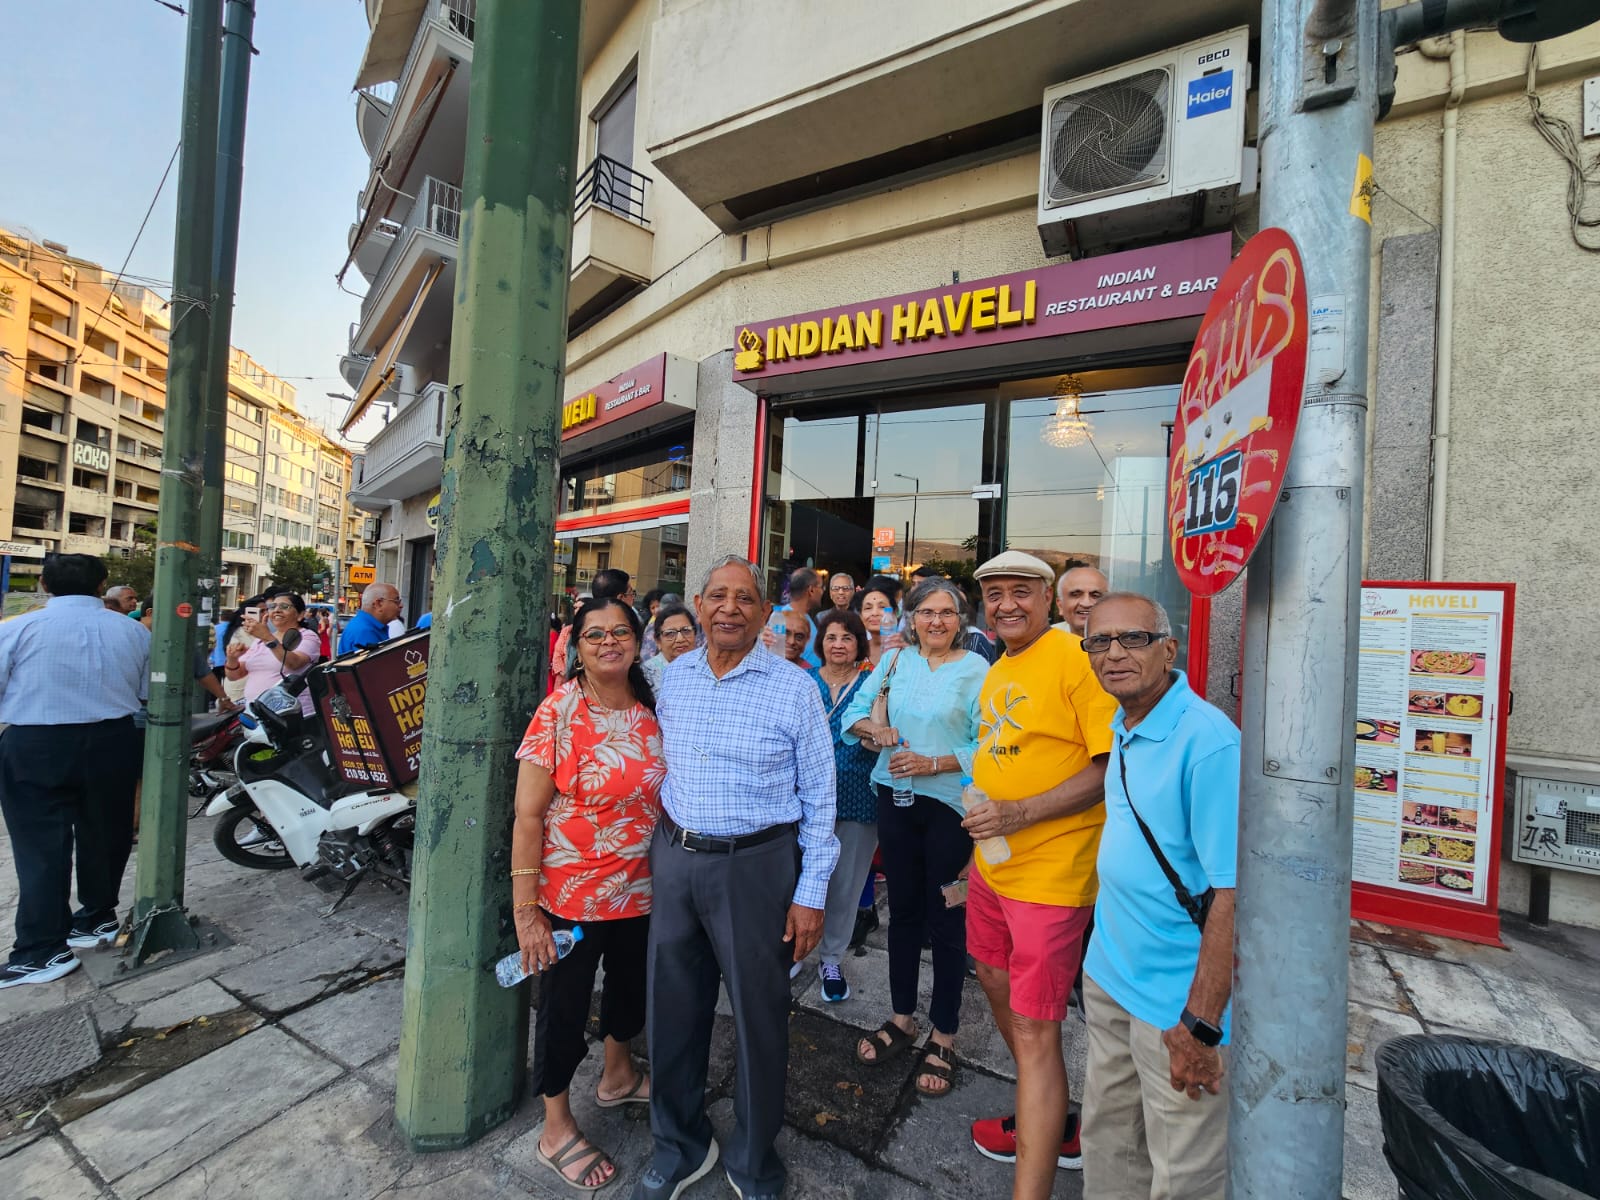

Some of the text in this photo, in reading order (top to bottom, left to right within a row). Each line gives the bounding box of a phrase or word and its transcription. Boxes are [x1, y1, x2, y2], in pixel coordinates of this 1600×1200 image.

[1188, 86, 1231, 106] Haier
[1097, 266, 1156, 289] INDIAN
[1045, 277, 1218, 316] RESTAURANT & BAR
[766, 280, 1036, 362] INDIAN HAVELI
[74, 443, 109, 470] ROKO
[1186, 452, 1241, 531] 115
[354, 571, 373, 579] ATM
[1408, 593, 1478, 608] HAVELI
[388, 680, 427, 713] IND
[332, 717, 371, 734] INAN
[1577, 848, 1600, 858] GX1
